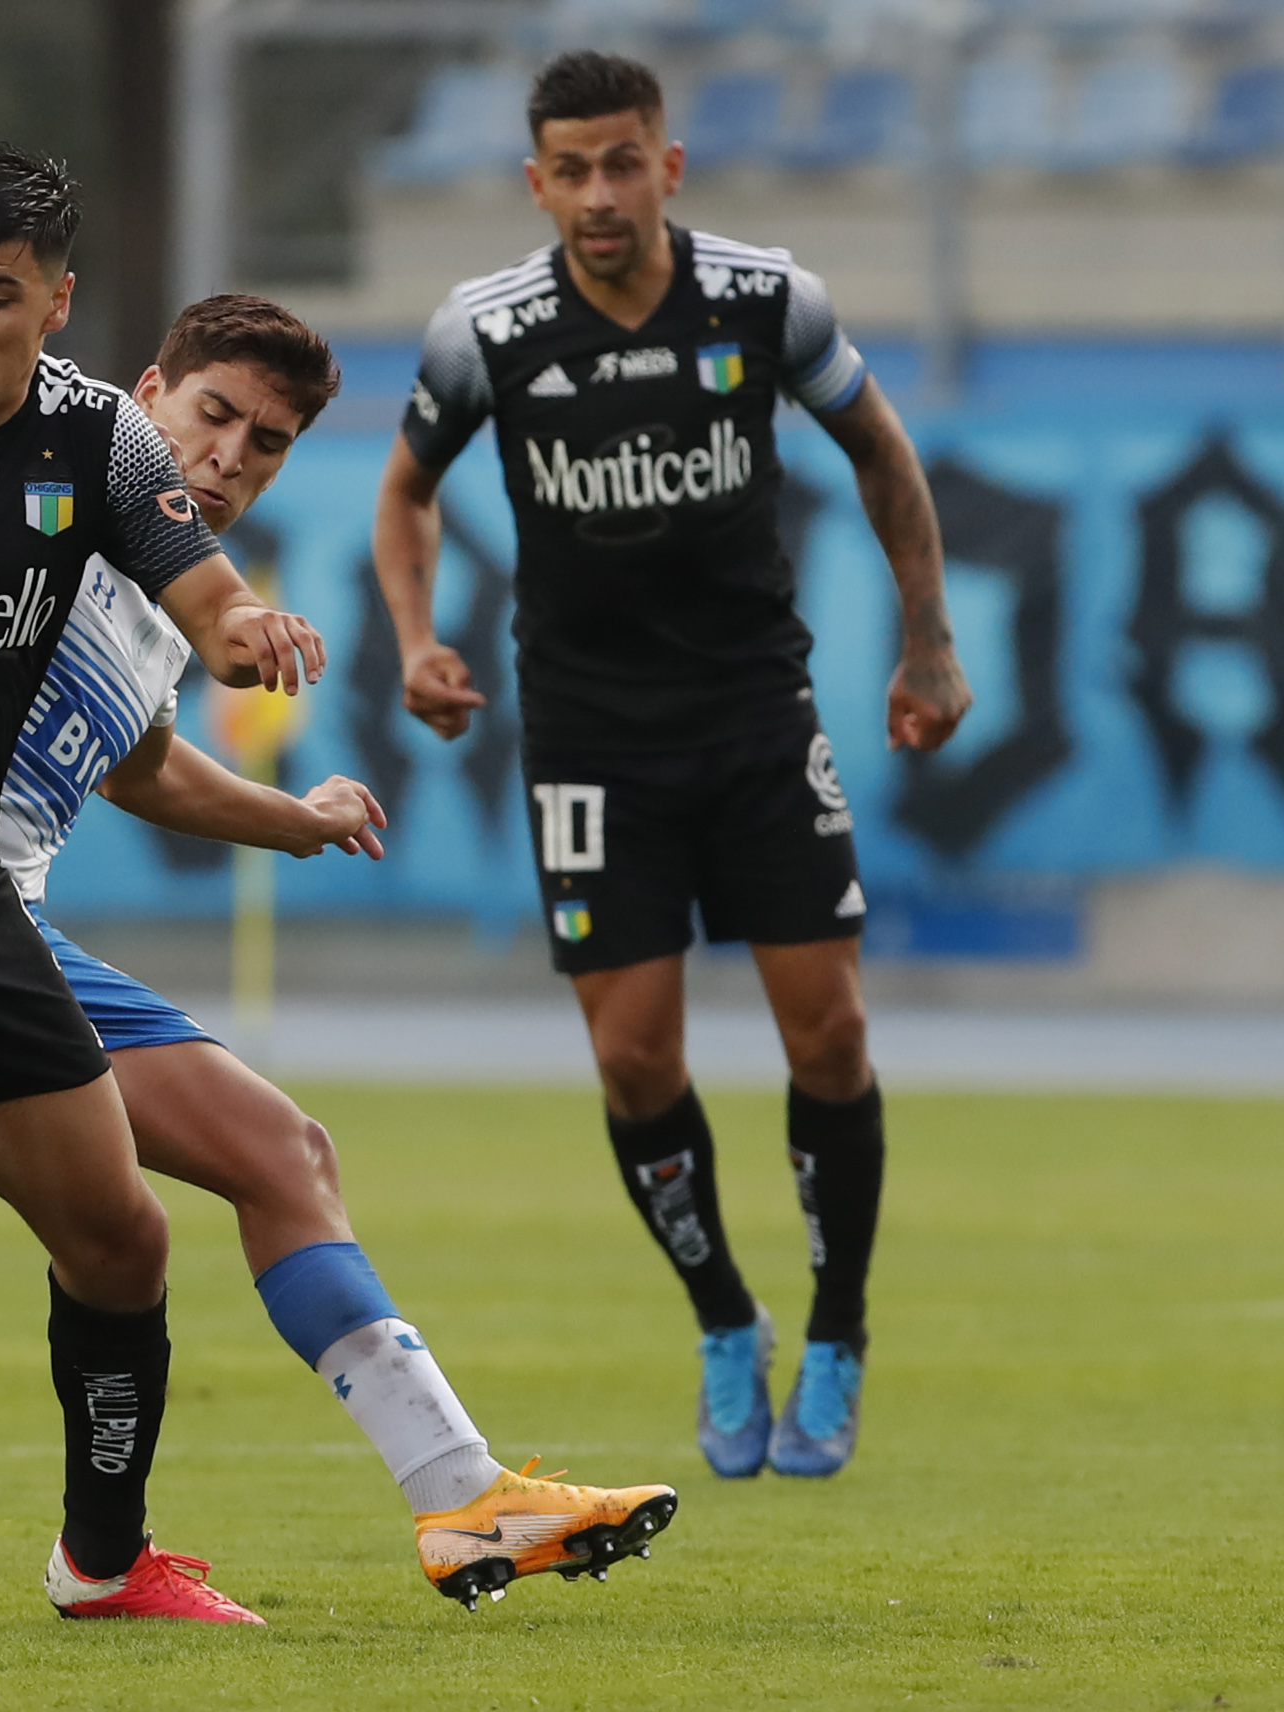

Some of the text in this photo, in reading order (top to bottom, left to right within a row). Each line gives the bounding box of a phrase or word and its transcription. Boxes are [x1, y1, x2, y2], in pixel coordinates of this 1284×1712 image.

[24, 482, 72, 494] O'HIGGINS
[526, 418, 752, 513] Monticello
[533, 782, 606, 873] 10
